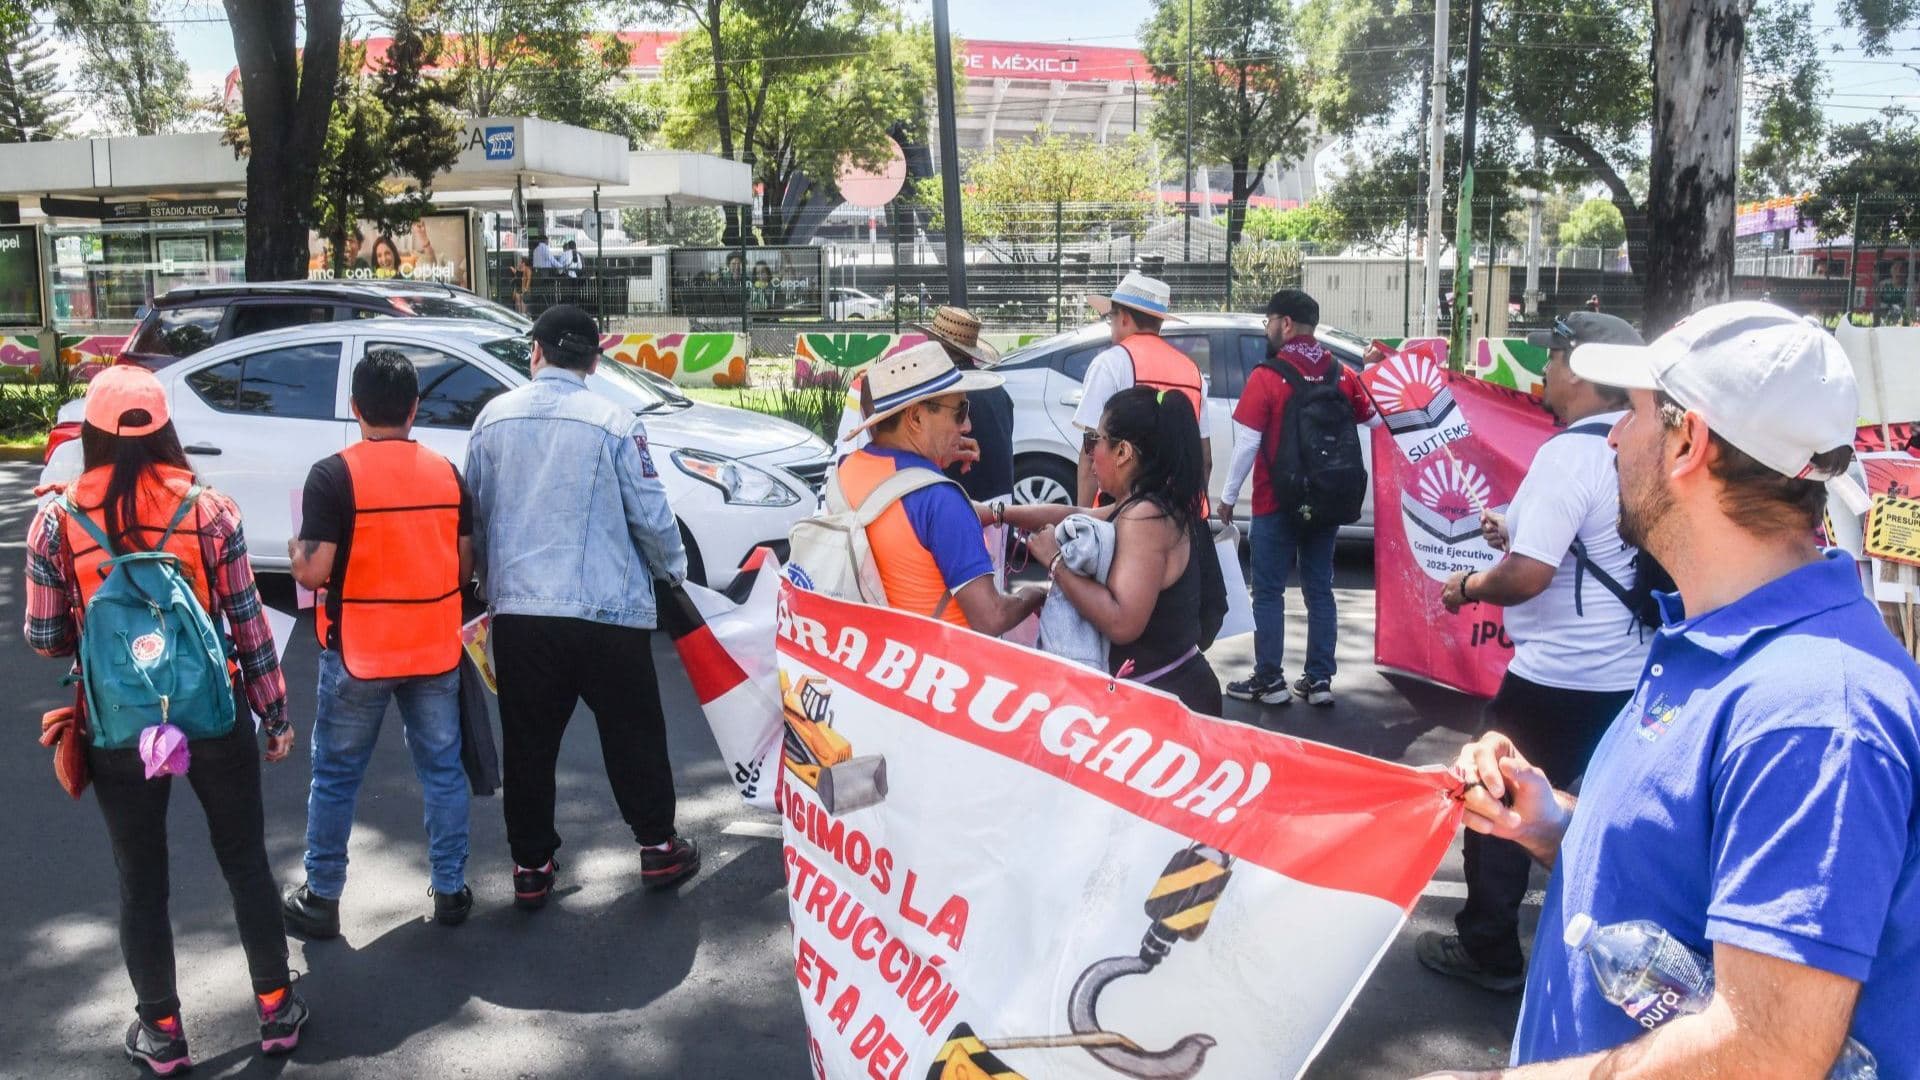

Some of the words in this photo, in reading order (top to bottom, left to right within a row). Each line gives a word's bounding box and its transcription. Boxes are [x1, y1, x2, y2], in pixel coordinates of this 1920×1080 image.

[992, 54, 1077, 73] MÉXICO
[150, 207, 185, 216] ESTADIO
[186, 205, 220, 215] AZTECA
[0, 234, 20, 253] pel
[346, 265, 372, 280] con
[771, 277, 809, 291] Coppel
[1408, 423, 1471, 463] SUTIEMS
[1414, 540, 1444, 555] Comité
[1446, 547, 1494, 561] Ejecutivo
[865, 638, 1272, 824] BRUGADA!
[899, 868, 970, 952] LA
